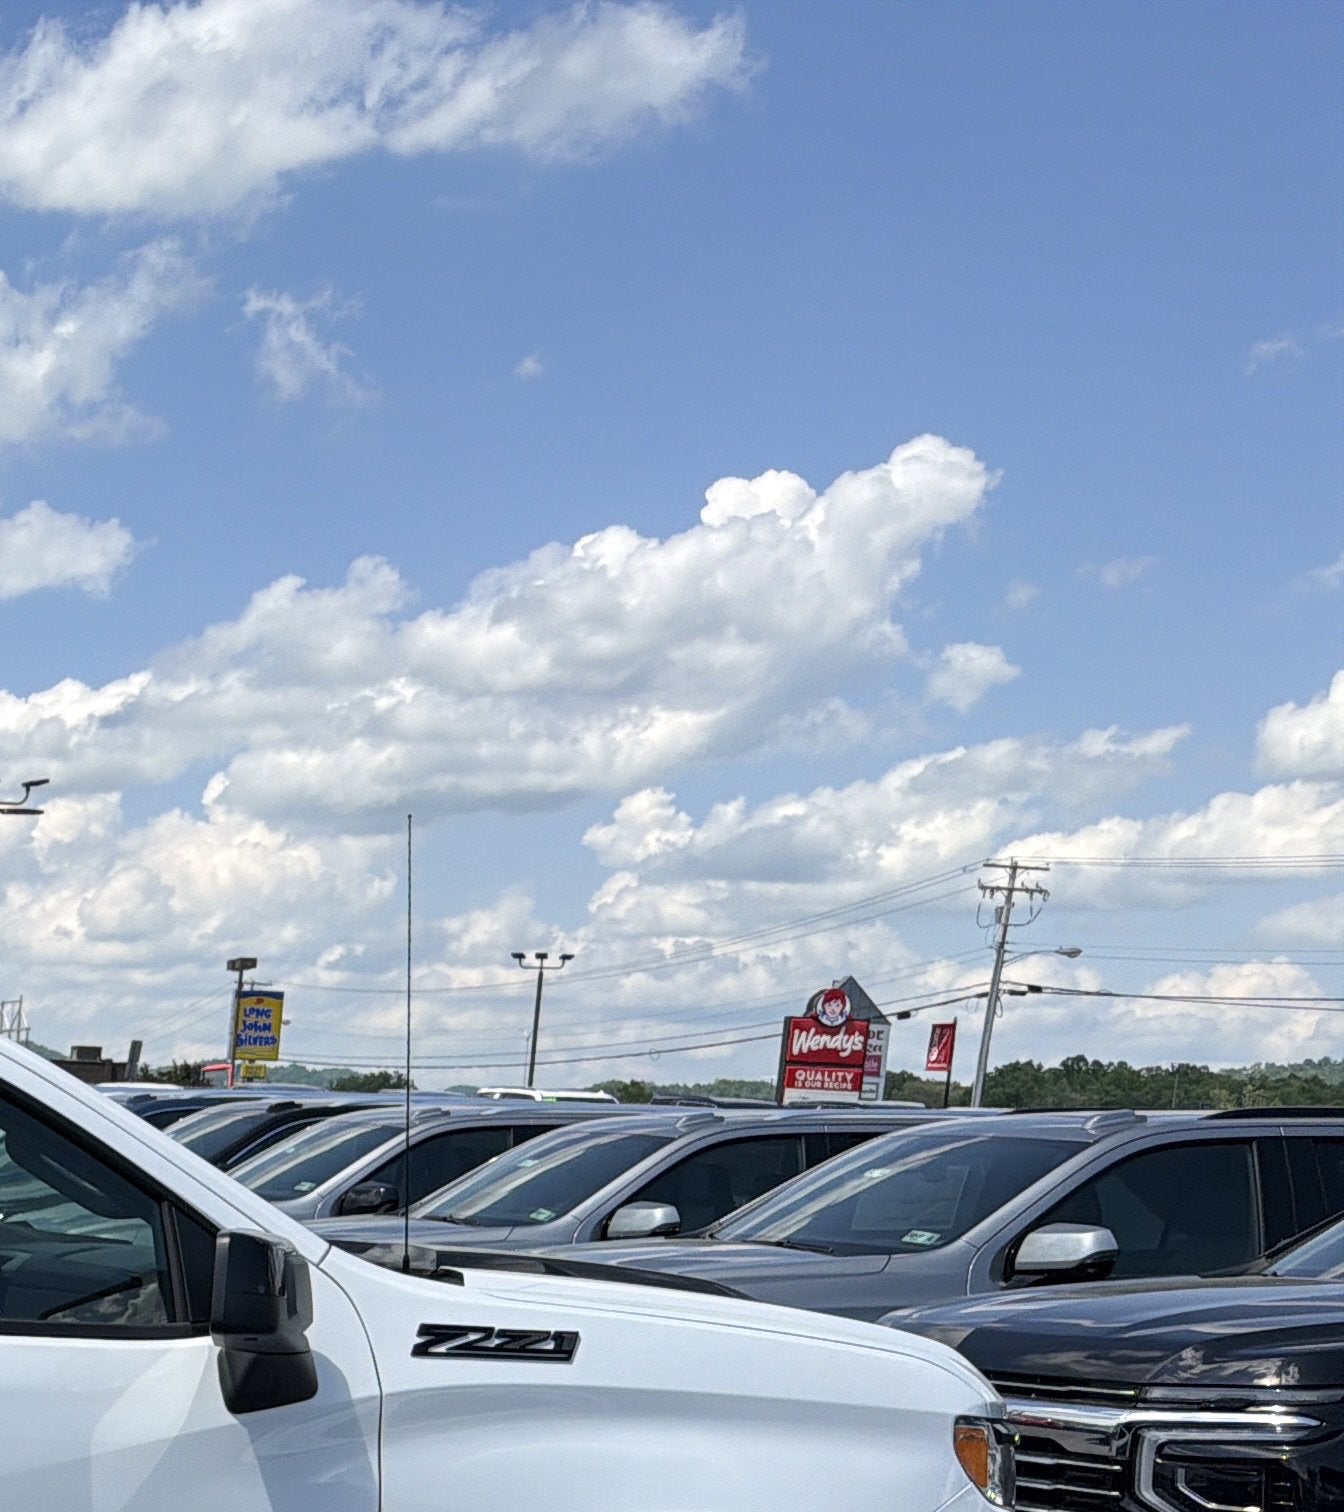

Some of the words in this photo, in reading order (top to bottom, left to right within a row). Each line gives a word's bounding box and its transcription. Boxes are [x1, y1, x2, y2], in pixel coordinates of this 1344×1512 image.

[792, 1026, 865, 1058] Wendy's
[795, 1069, 855, 1082] QUALITY
[410, 1322, 581, 1365] Z71
